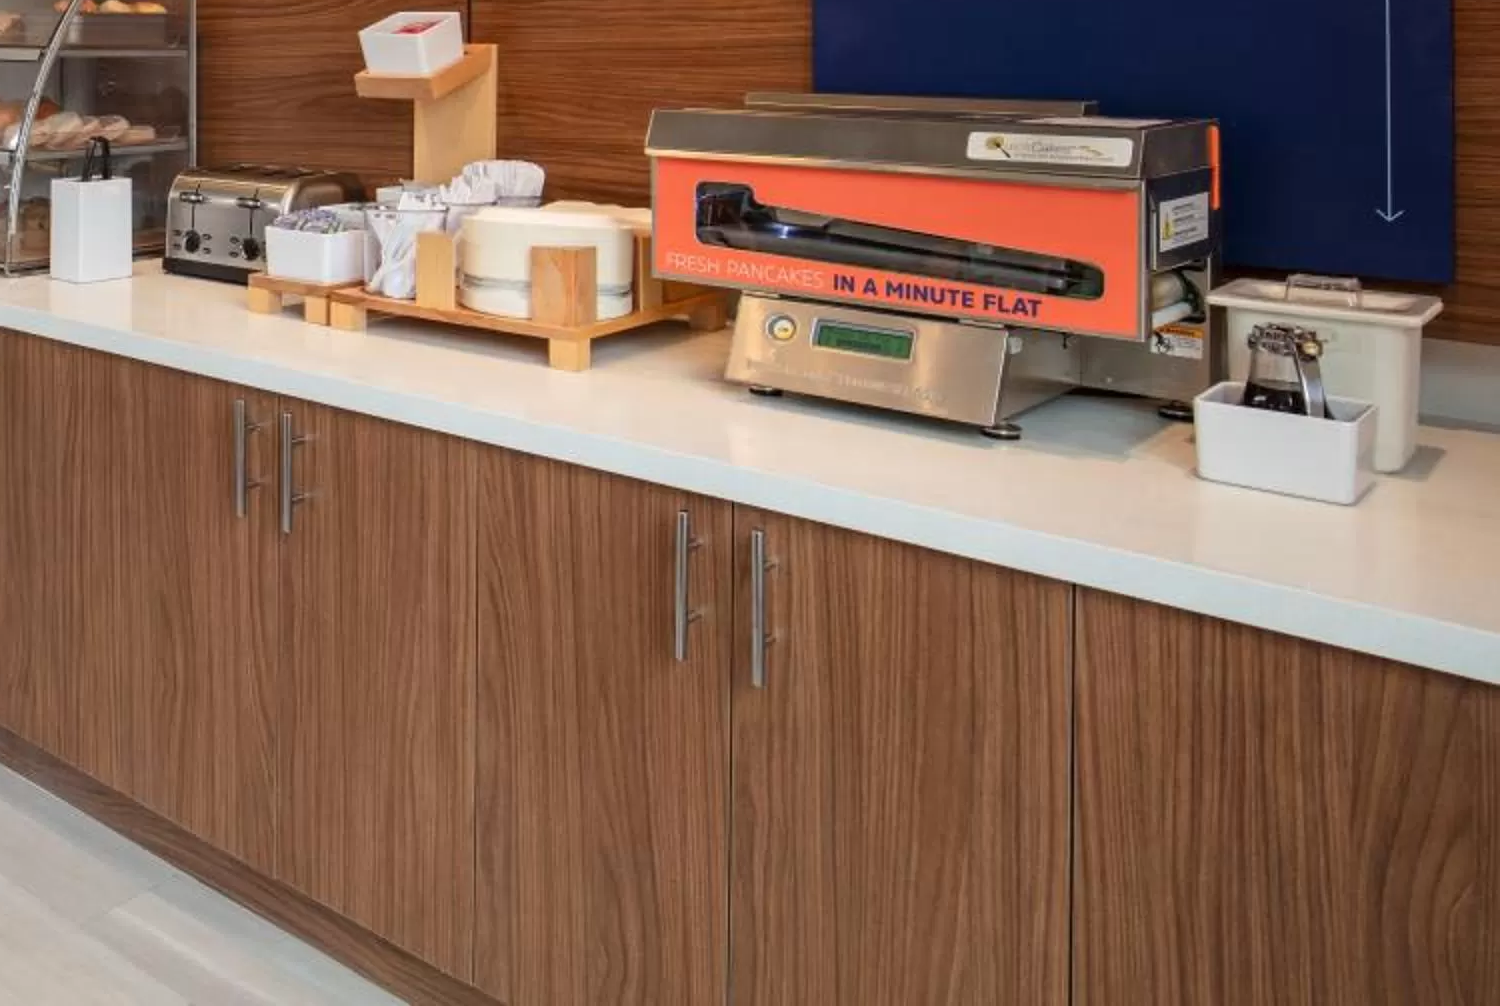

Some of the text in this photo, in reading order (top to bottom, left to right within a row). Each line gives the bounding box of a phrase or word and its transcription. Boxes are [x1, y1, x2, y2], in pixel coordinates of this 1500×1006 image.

[665, 252, 1043, 319] FRESH PANCAKES IN A MINUTE FLAT
